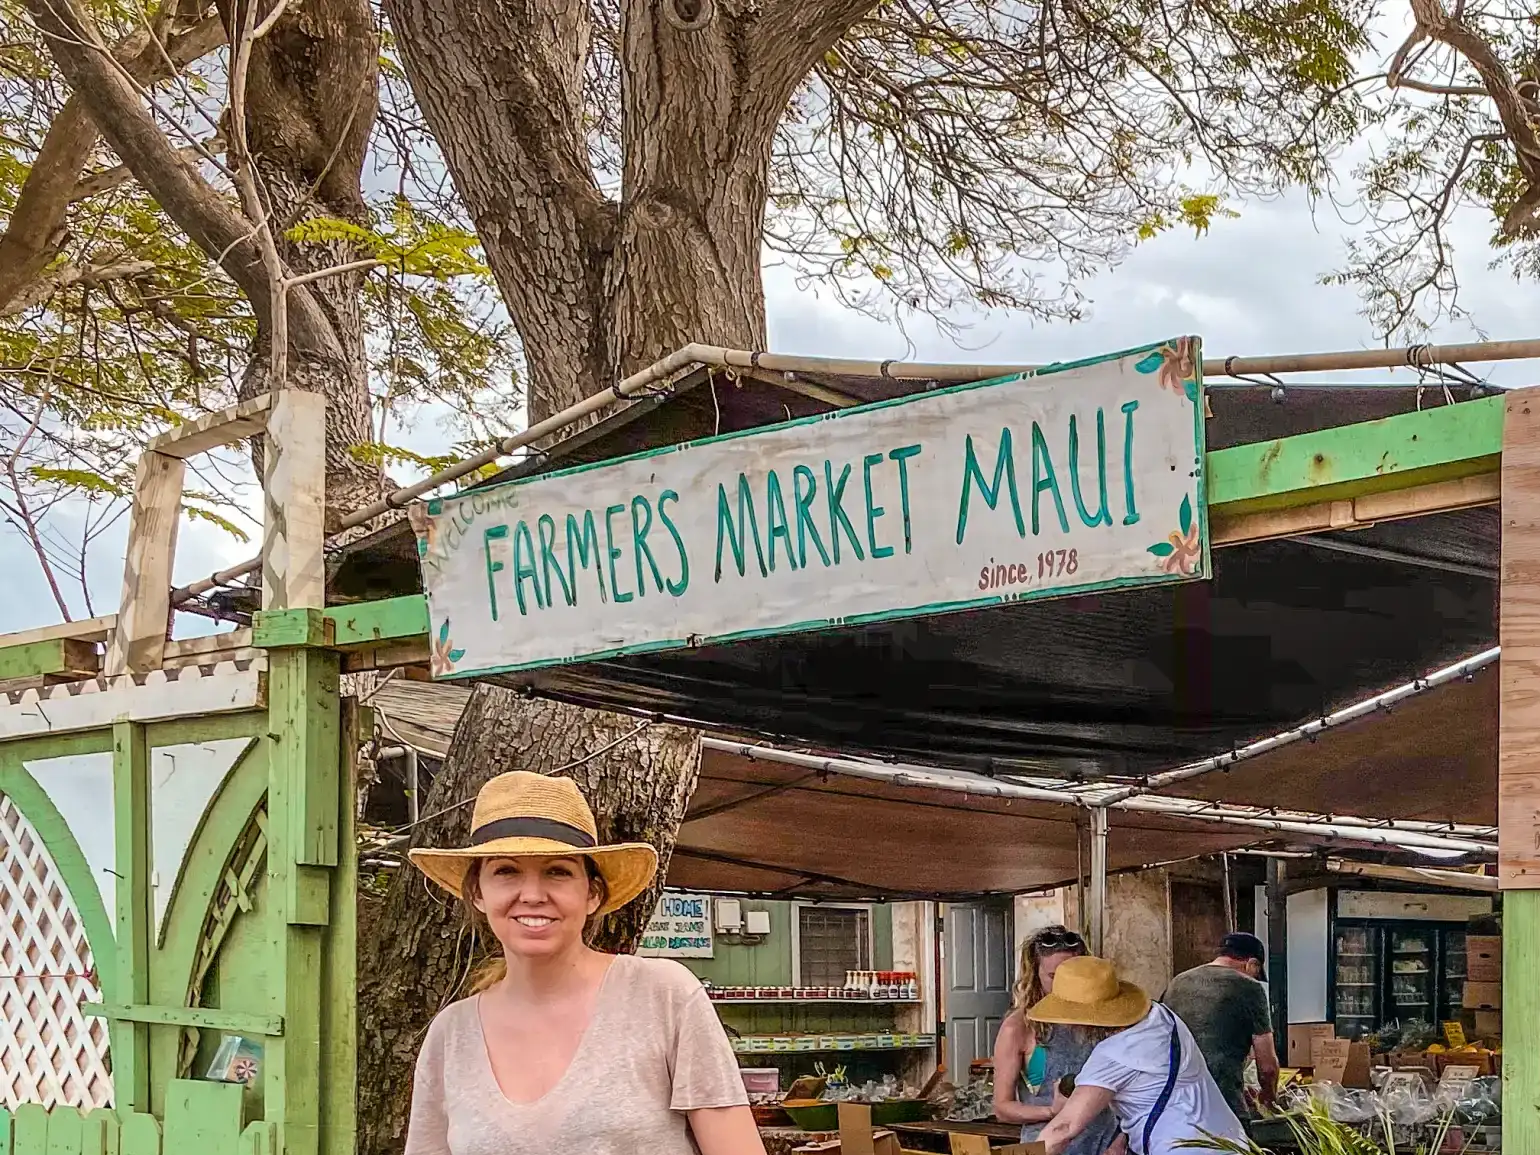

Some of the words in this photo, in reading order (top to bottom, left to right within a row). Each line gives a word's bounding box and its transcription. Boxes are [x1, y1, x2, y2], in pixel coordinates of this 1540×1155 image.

[484, 489, 689, 622] FARMERS
[715, 443, 922, 584] MARKET
[955, 400, 1141, 547] MAUI
[1037, 548, 1079, 578] 1978
